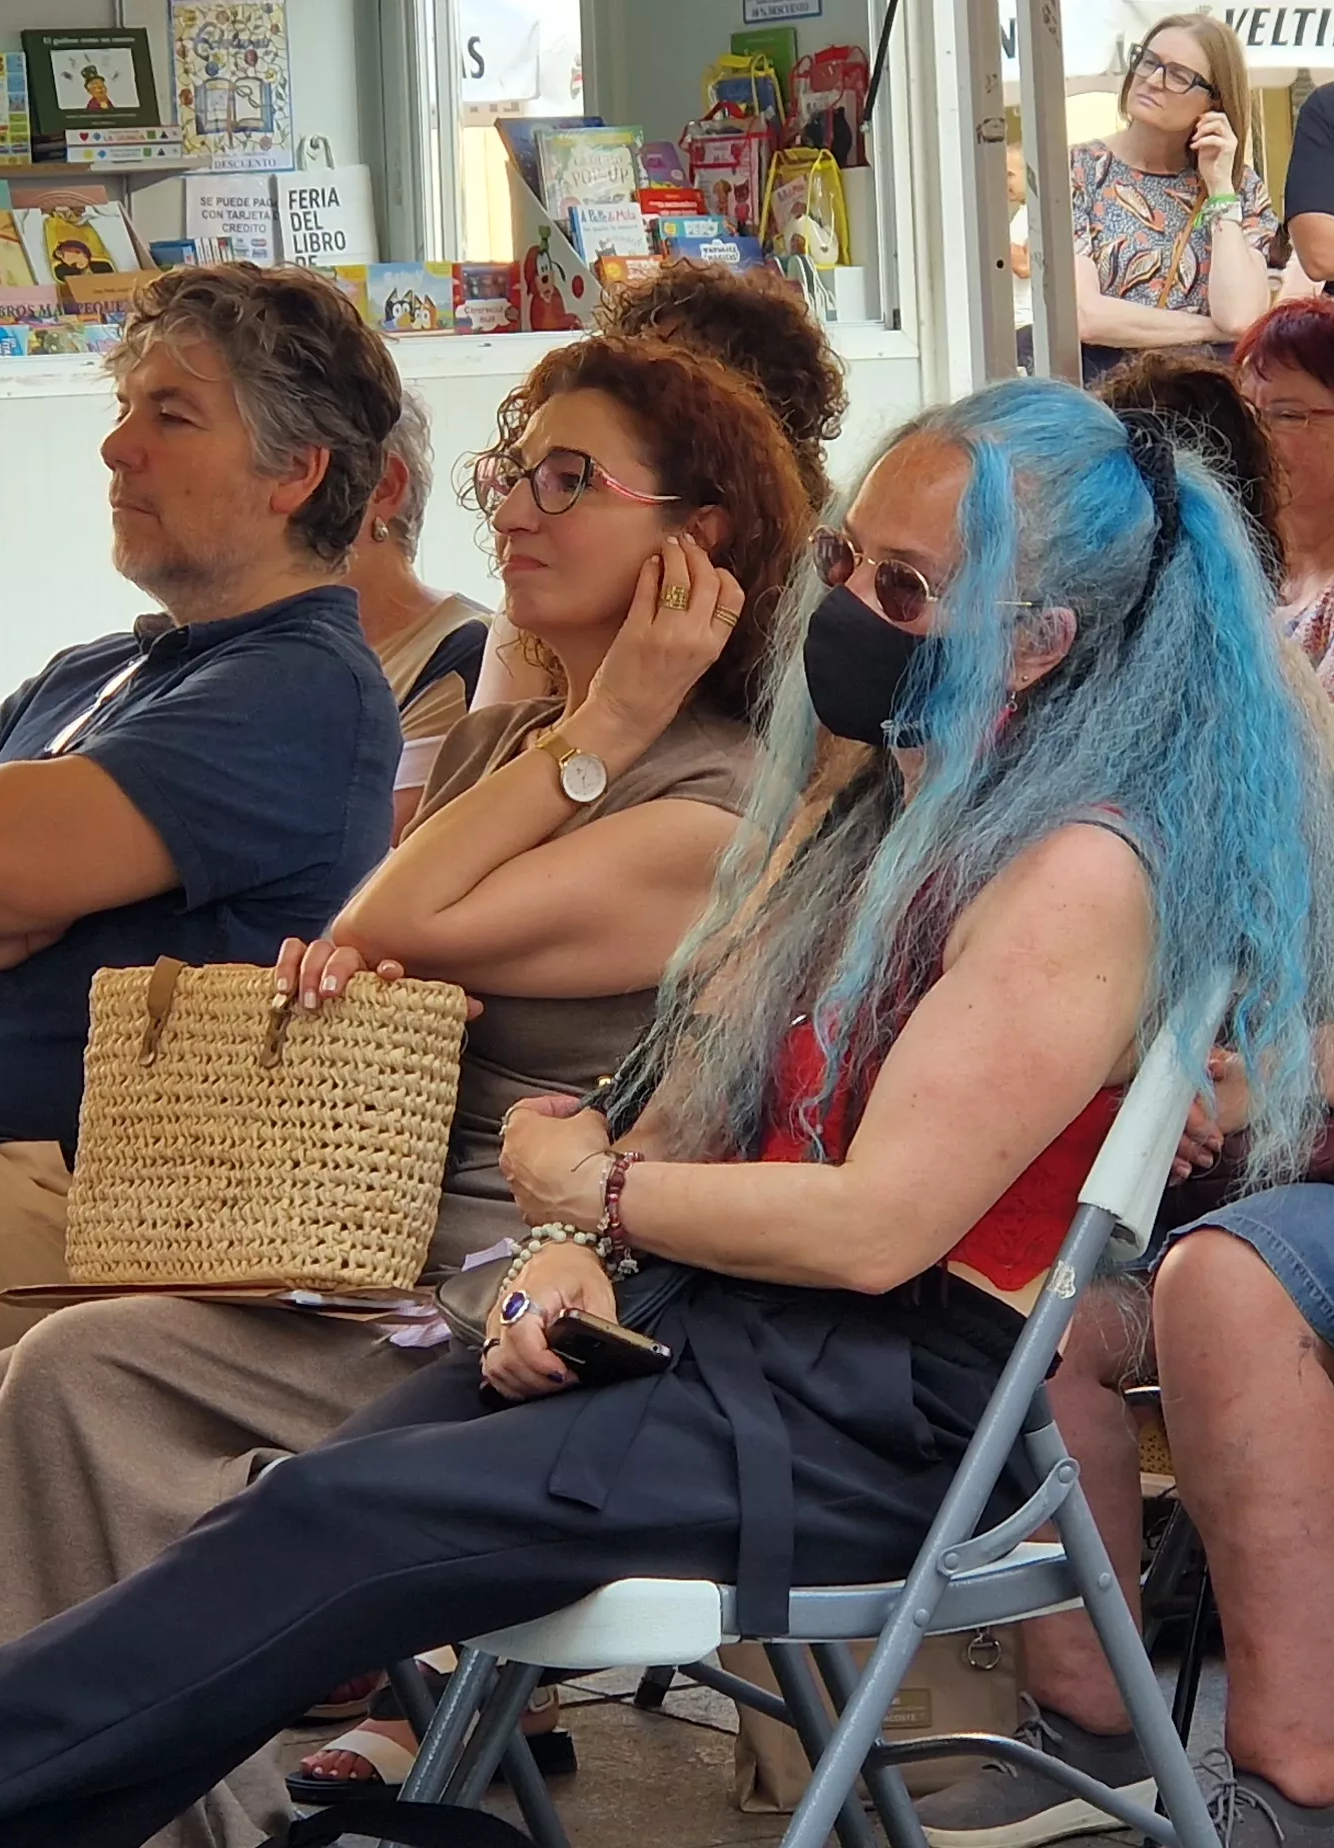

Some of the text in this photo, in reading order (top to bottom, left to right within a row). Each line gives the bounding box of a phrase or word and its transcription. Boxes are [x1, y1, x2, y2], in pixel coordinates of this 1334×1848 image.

[200, 196, 213, 206] SE
[216, 196, 250, 207] PUEDE
[289, 187, 340, 210] FERIA
[201, 210, 224, 220] CON
[226, 210, 270, 220] TARJETA
[290, 211, 324, 232] DEL
[293, 231, 346, 253] LIBRO
